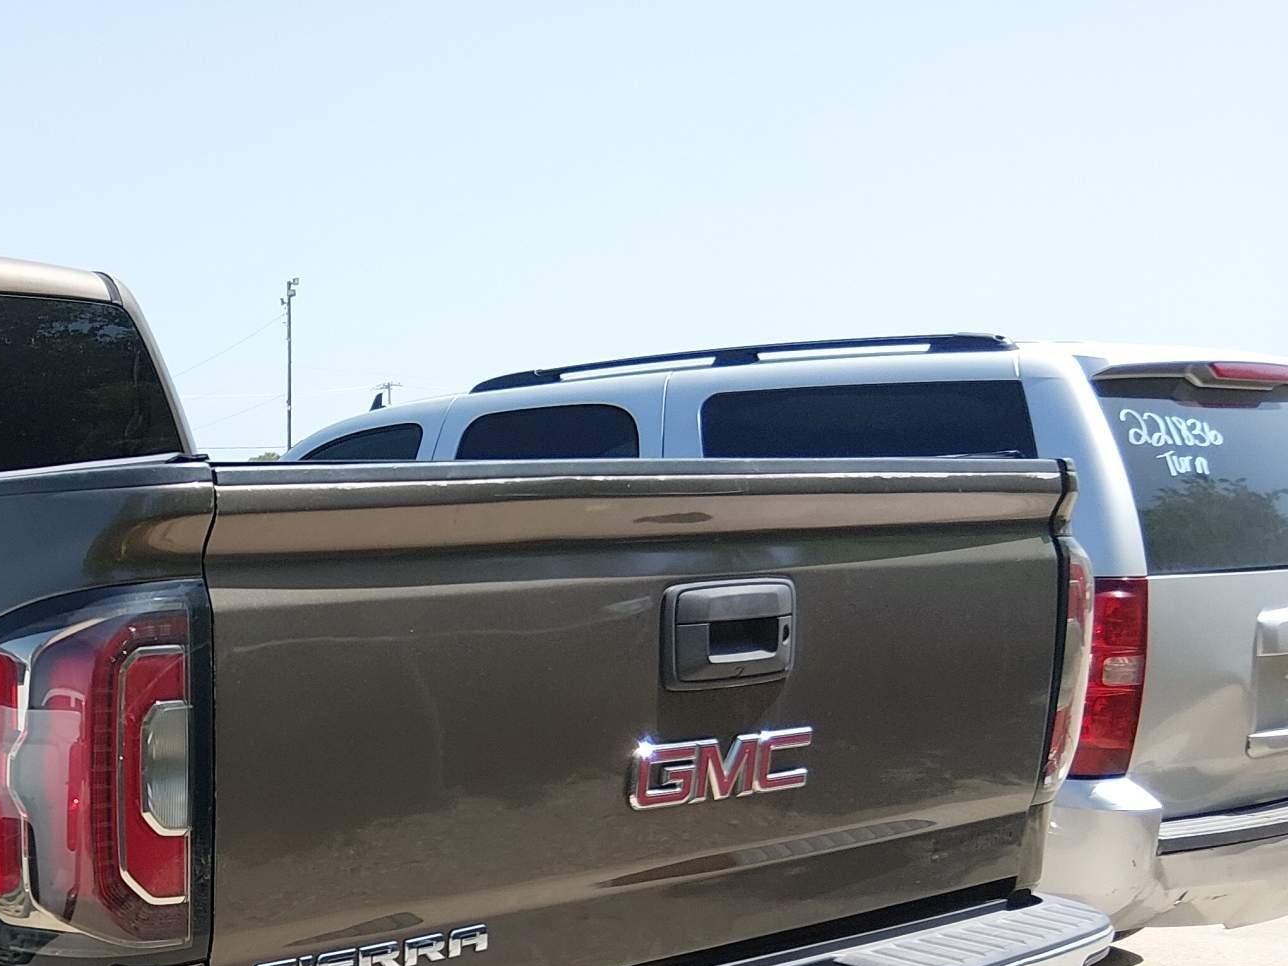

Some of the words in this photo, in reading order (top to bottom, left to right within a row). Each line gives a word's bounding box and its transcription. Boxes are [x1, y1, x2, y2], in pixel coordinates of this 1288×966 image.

[1119, 408, 1224, 447] 221836
[1155, 450, 1211, 476] Turn
[629, 725, 814, 810] GMC
